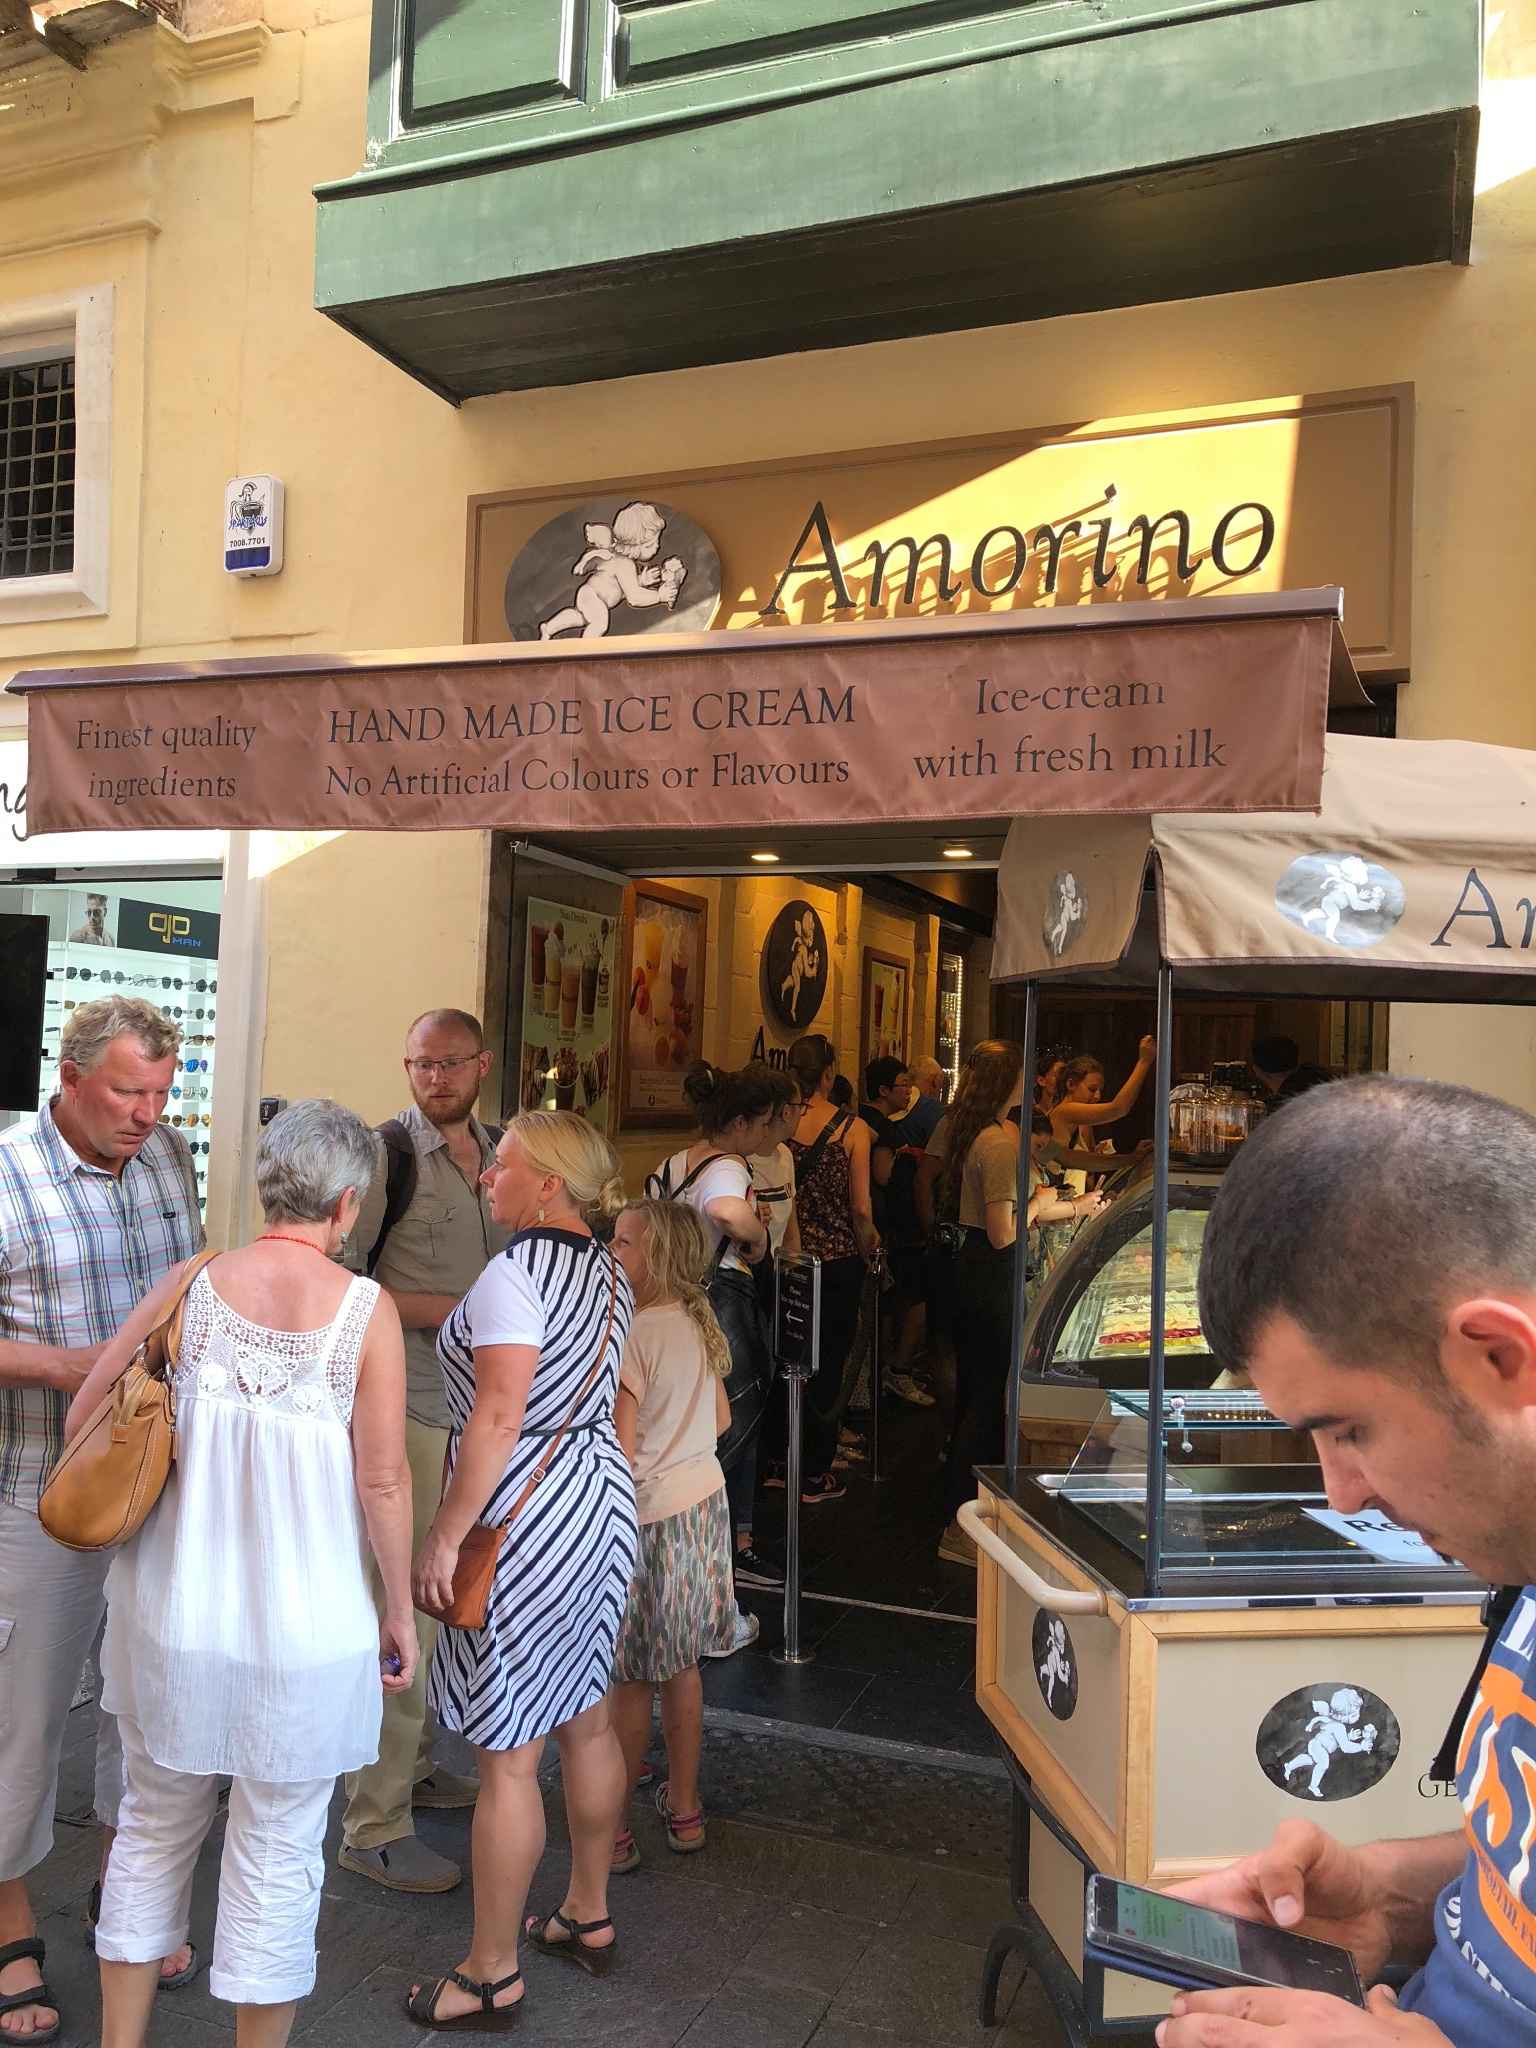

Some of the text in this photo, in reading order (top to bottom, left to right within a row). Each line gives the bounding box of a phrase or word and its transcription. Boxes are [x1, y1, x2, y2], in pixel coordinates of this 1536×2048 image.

[759, 483, 1276, 616] Amorino
[328, 685, 857, 743] HAND MADE ICE CREAM
[976, 679, 1166, 715] Ice-cream
[76, 715, 257, 753] Finest quality
[913, 728, 1228, 779] with fresh milk
[88, 765, 237, 804] ingredients
[325, 752, 850, 797] No Artificial Colours or Flavours
